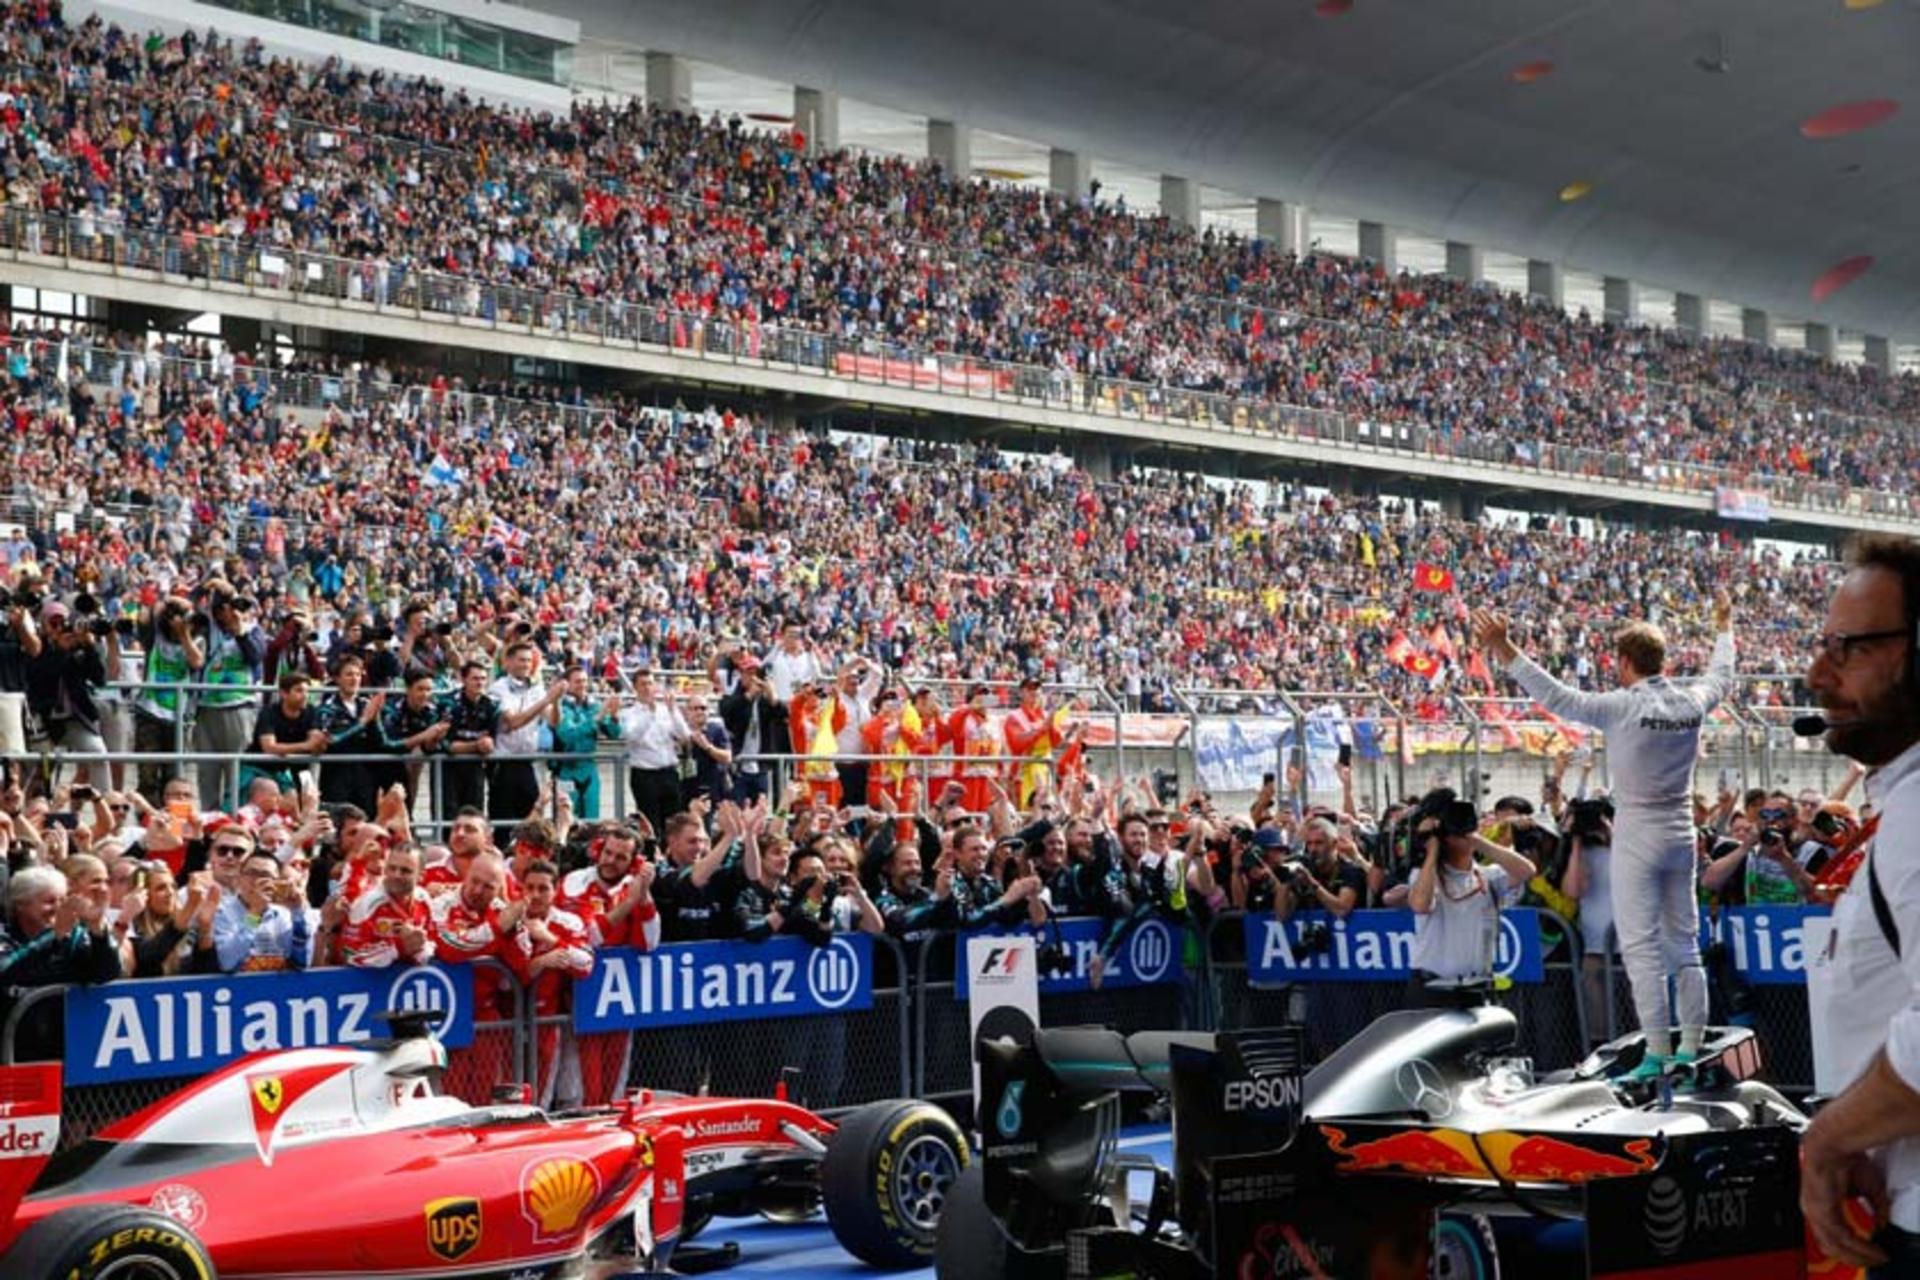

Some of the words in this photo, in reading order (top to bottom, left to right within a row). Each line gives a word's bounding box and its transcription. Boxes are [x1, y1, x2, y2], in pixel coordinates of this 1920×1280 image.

[595, 952, 796, 1017] Allianz
[94, 988, 371, 1068] Allianz
[1224, 1076, 1300, 1111] EPSON
[0, 1122, 44, 1152] der
[696, 1113, 762, 1137] Santander
[1694, 1187, 1749, 1231] AT&T
[88, 1227, 182, 1265] ZERO
[431, 1213, 479, 1252] ups
